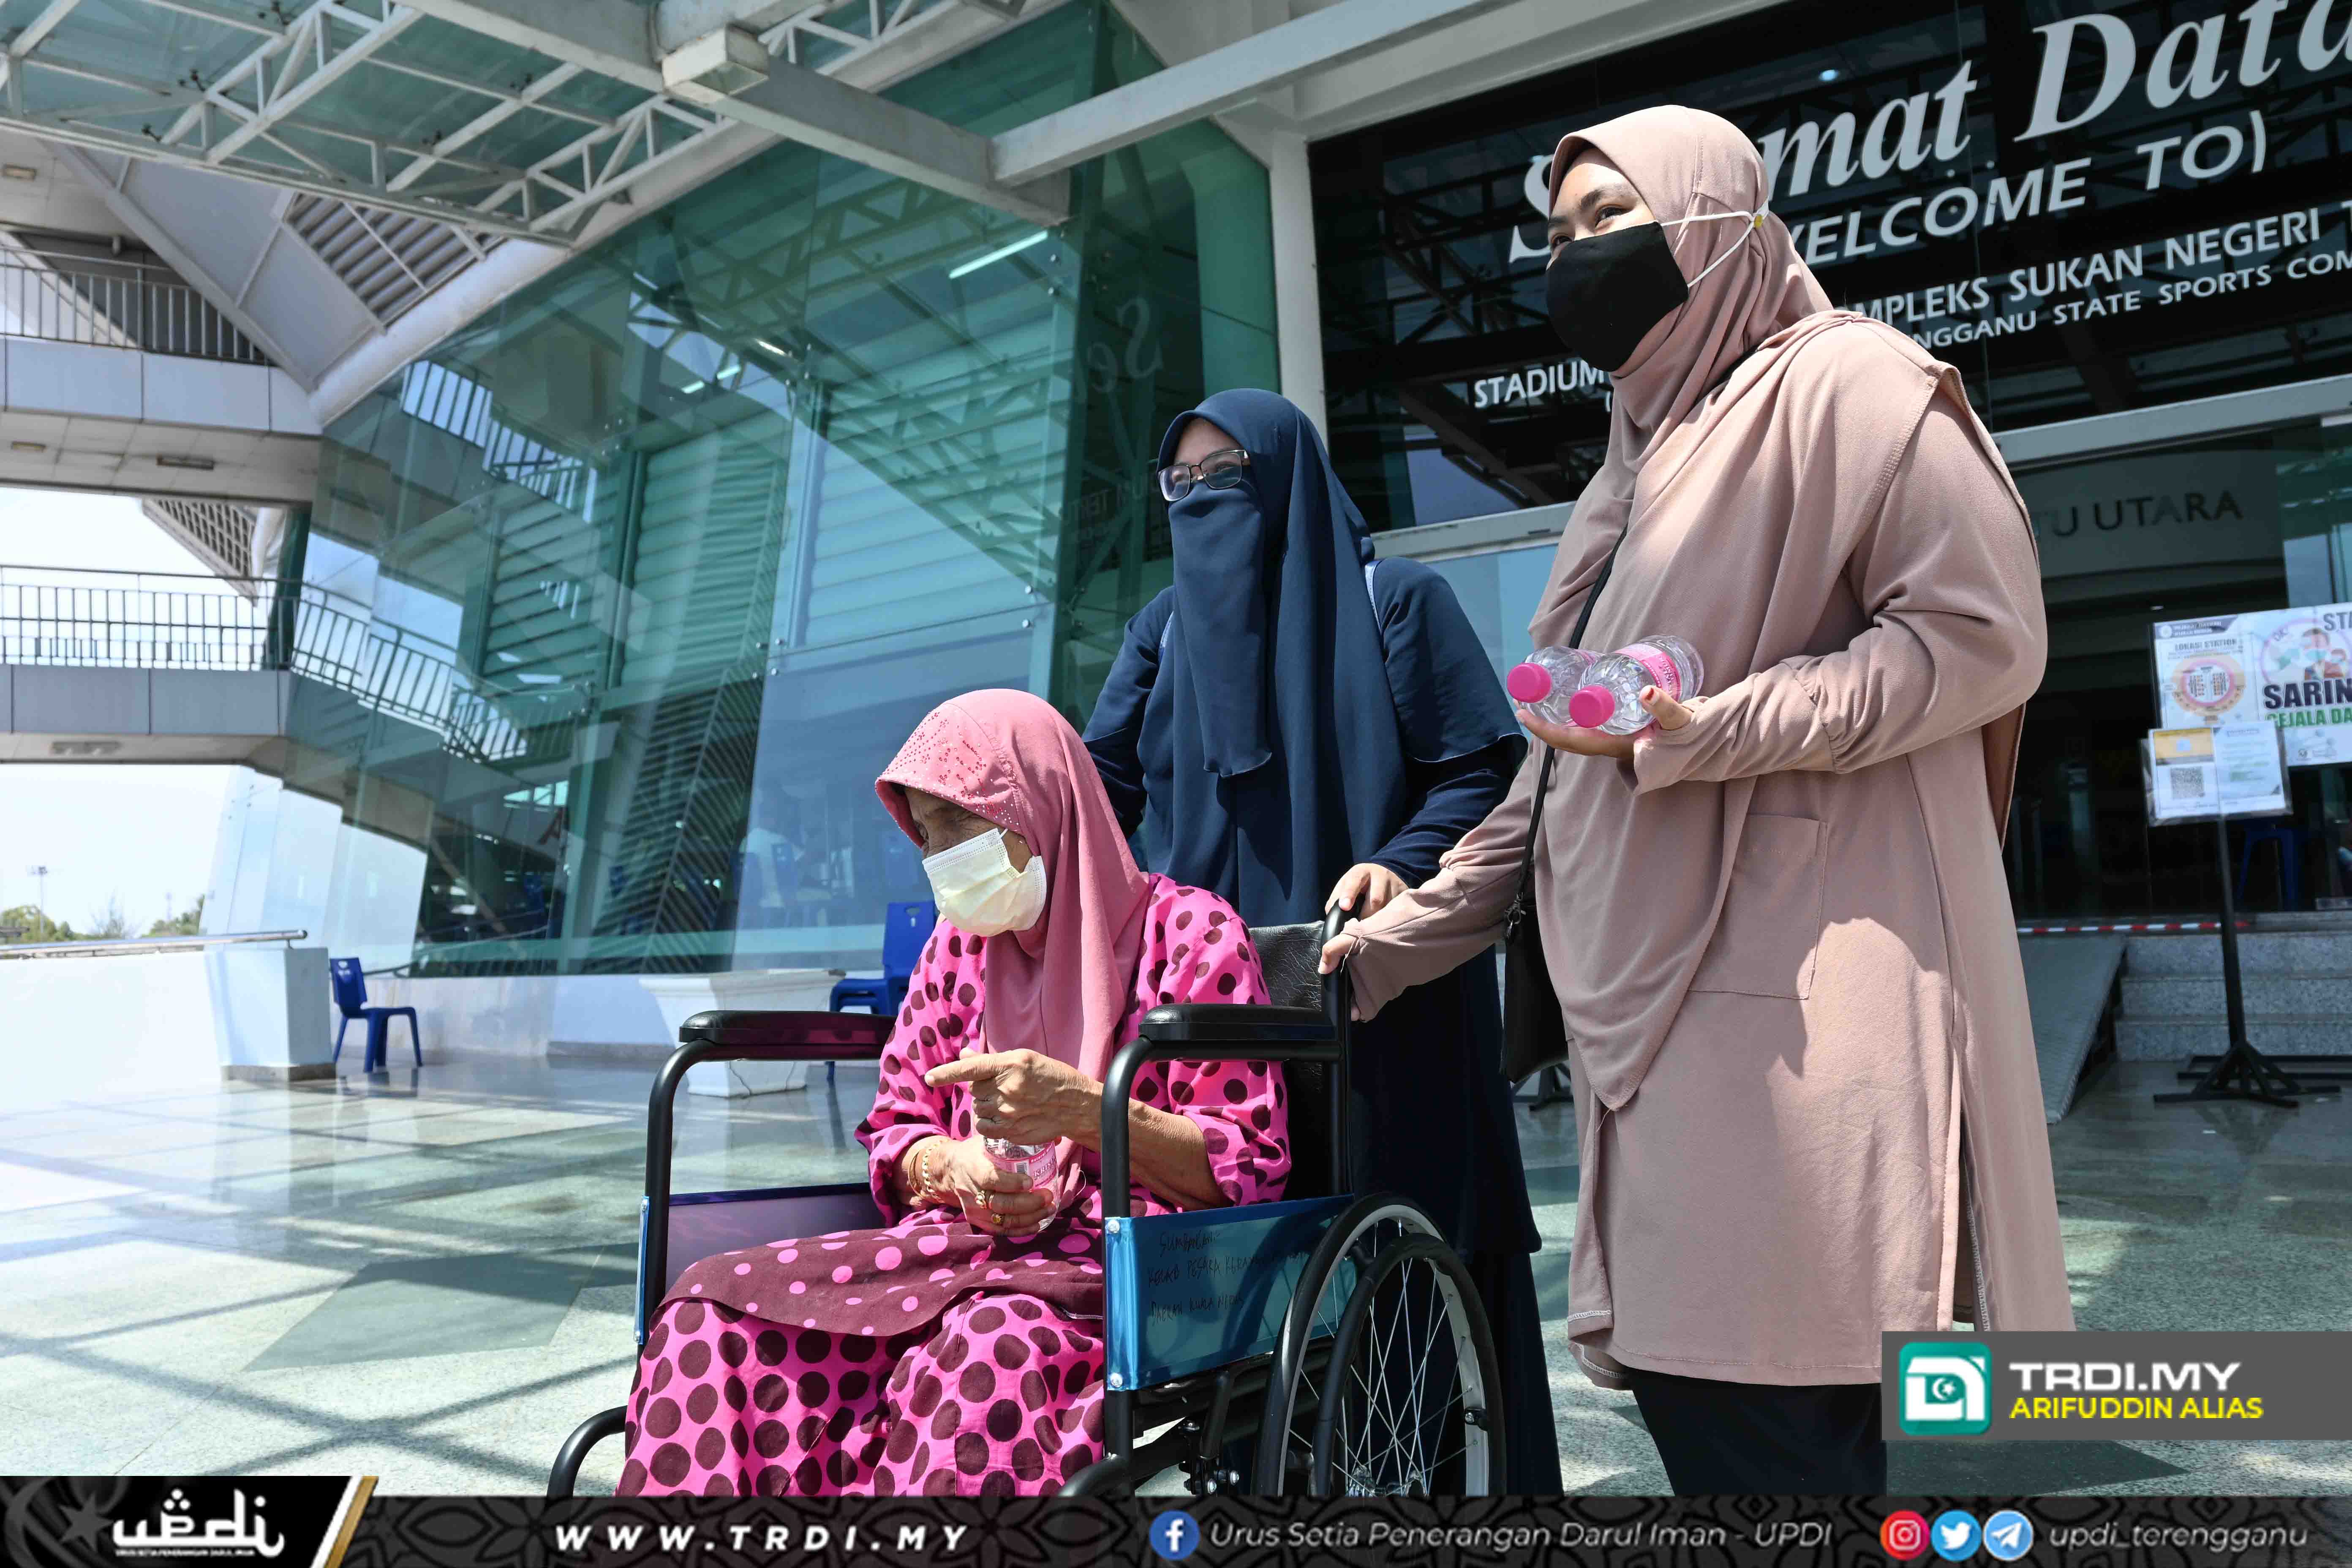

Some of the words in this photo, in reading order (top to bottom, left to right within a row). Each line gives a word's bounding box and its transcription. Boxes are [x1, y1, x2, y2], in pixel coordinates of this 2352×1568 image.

[1788, 158, 2091, 266] ELCOME
[2137, 110, 2266, 190] TO)
[1474, 359, 1605, 408] STADIUM
[1835, 276, 1991, 325] MPLEKS
[2009, 245, 2143, 302] SUKAN
[2165, 207, 2320, 270] NEGERI
[1910, 310, 2036, 350] NGGANU
[2053, 290, 2141, 325] STATE
[2158, 264, 2271, 305] SPORTS
[2093, 491, 2243, 531] UTARA
[2264, 678, 2352, 709] SARIN
